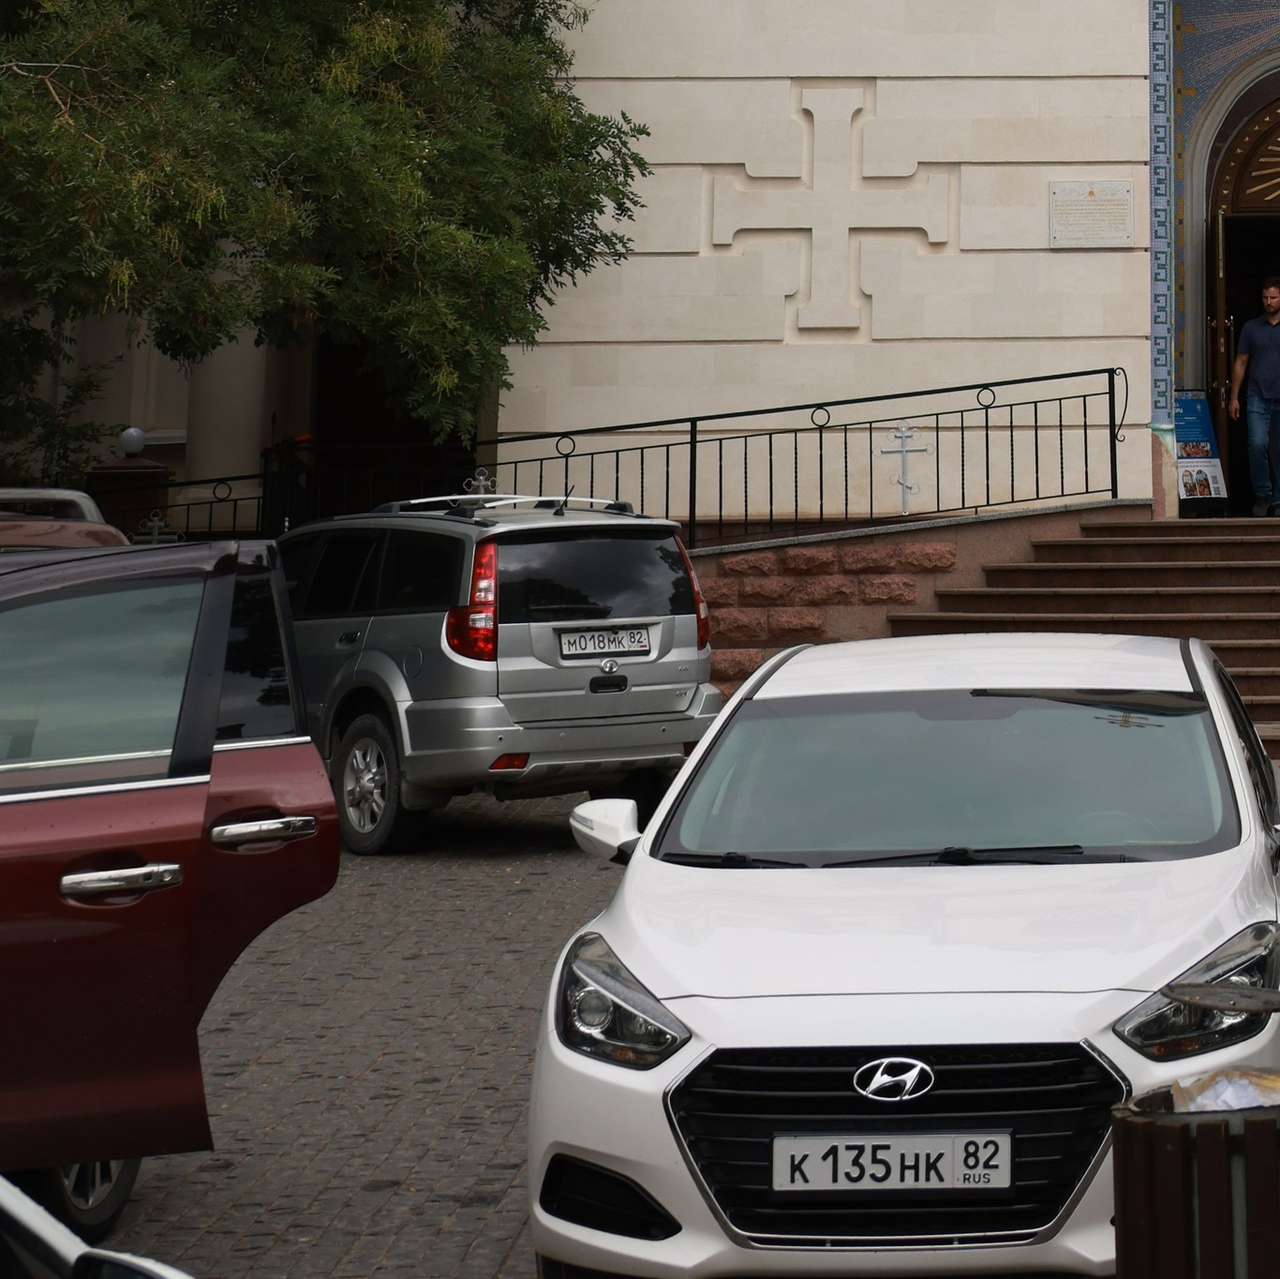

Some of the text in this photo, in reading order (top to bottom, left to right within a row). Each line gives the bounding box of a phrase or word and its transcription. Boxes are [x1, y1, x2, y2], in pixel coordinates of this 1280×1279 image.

[790, 1139, 999, 1184] К135НК 82
[963, 1173, 991, 1184] RUS
